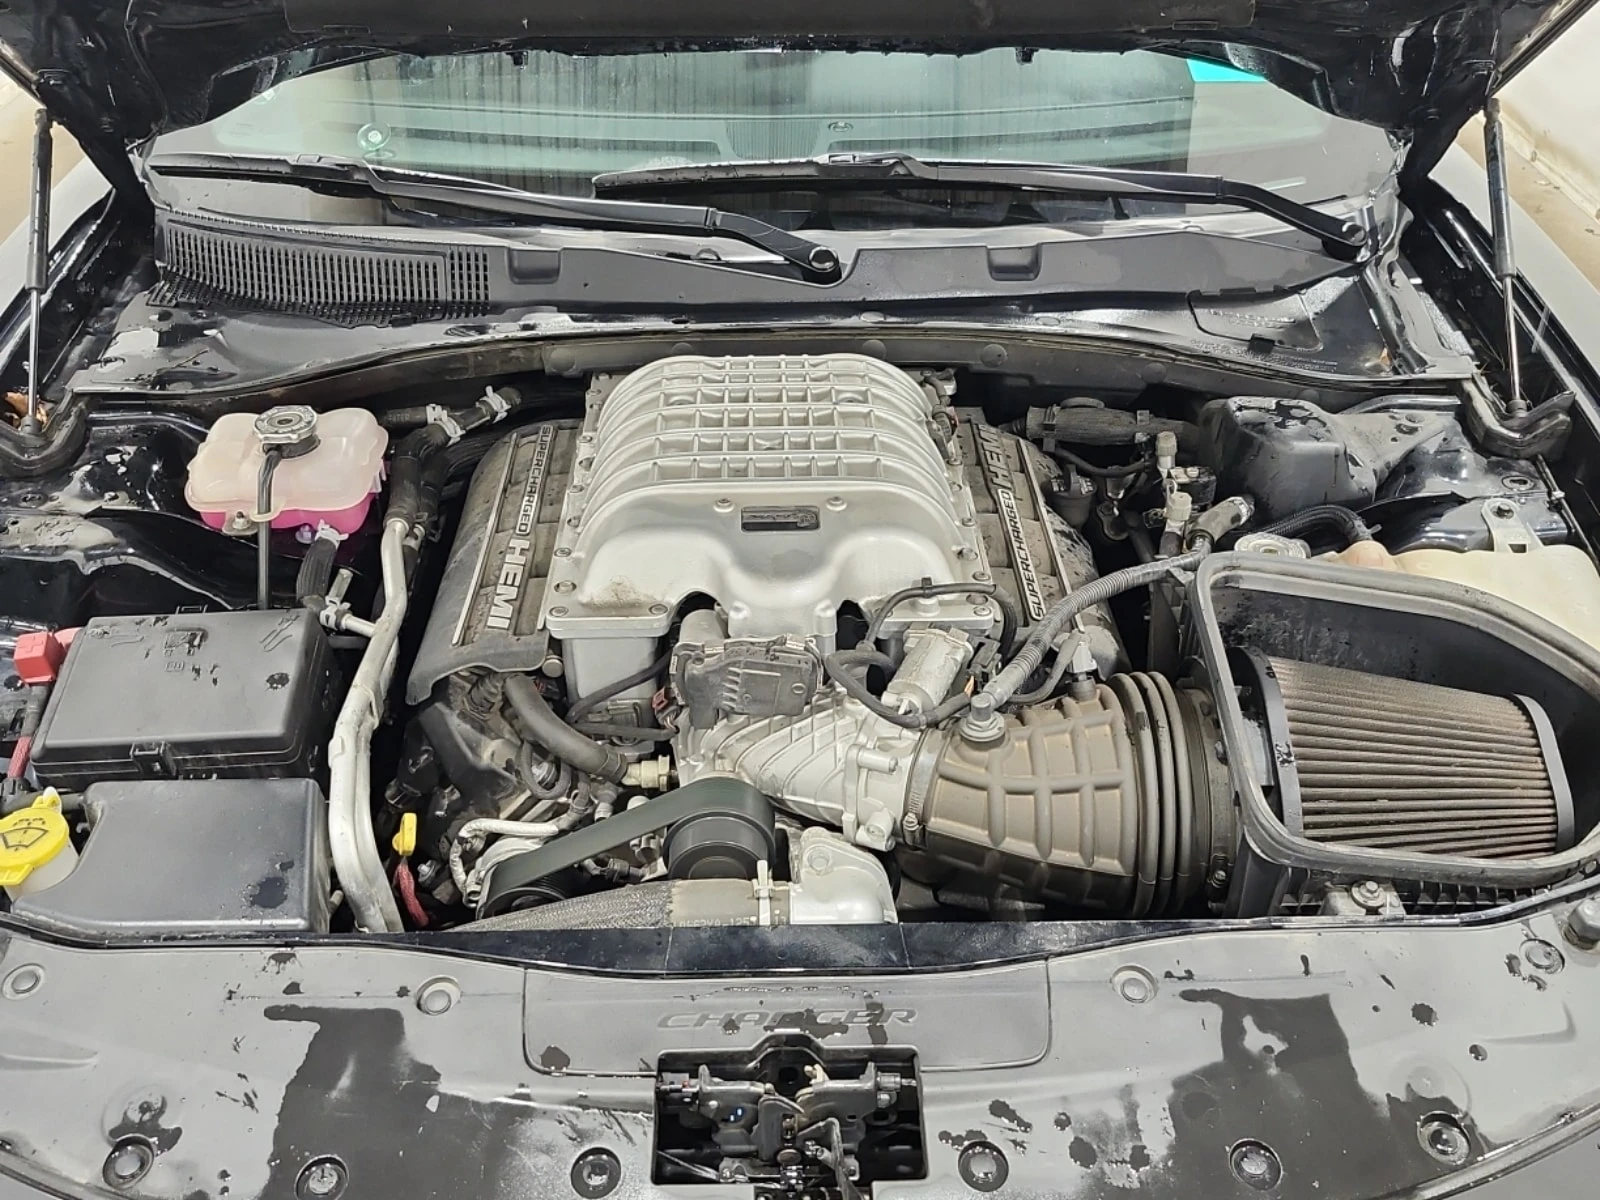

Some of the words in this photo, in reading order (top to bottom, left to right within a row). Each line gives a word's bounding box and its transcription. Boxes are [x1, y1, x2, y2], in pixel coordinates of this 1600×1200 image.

[517, 425, 553, 534] SUPERCHARGED
[977, 423, 1013, 491] HEMI
[487, 538, 530, 629] HEMI
[1000, 490, 1044, 619] SUPERCHARGED
